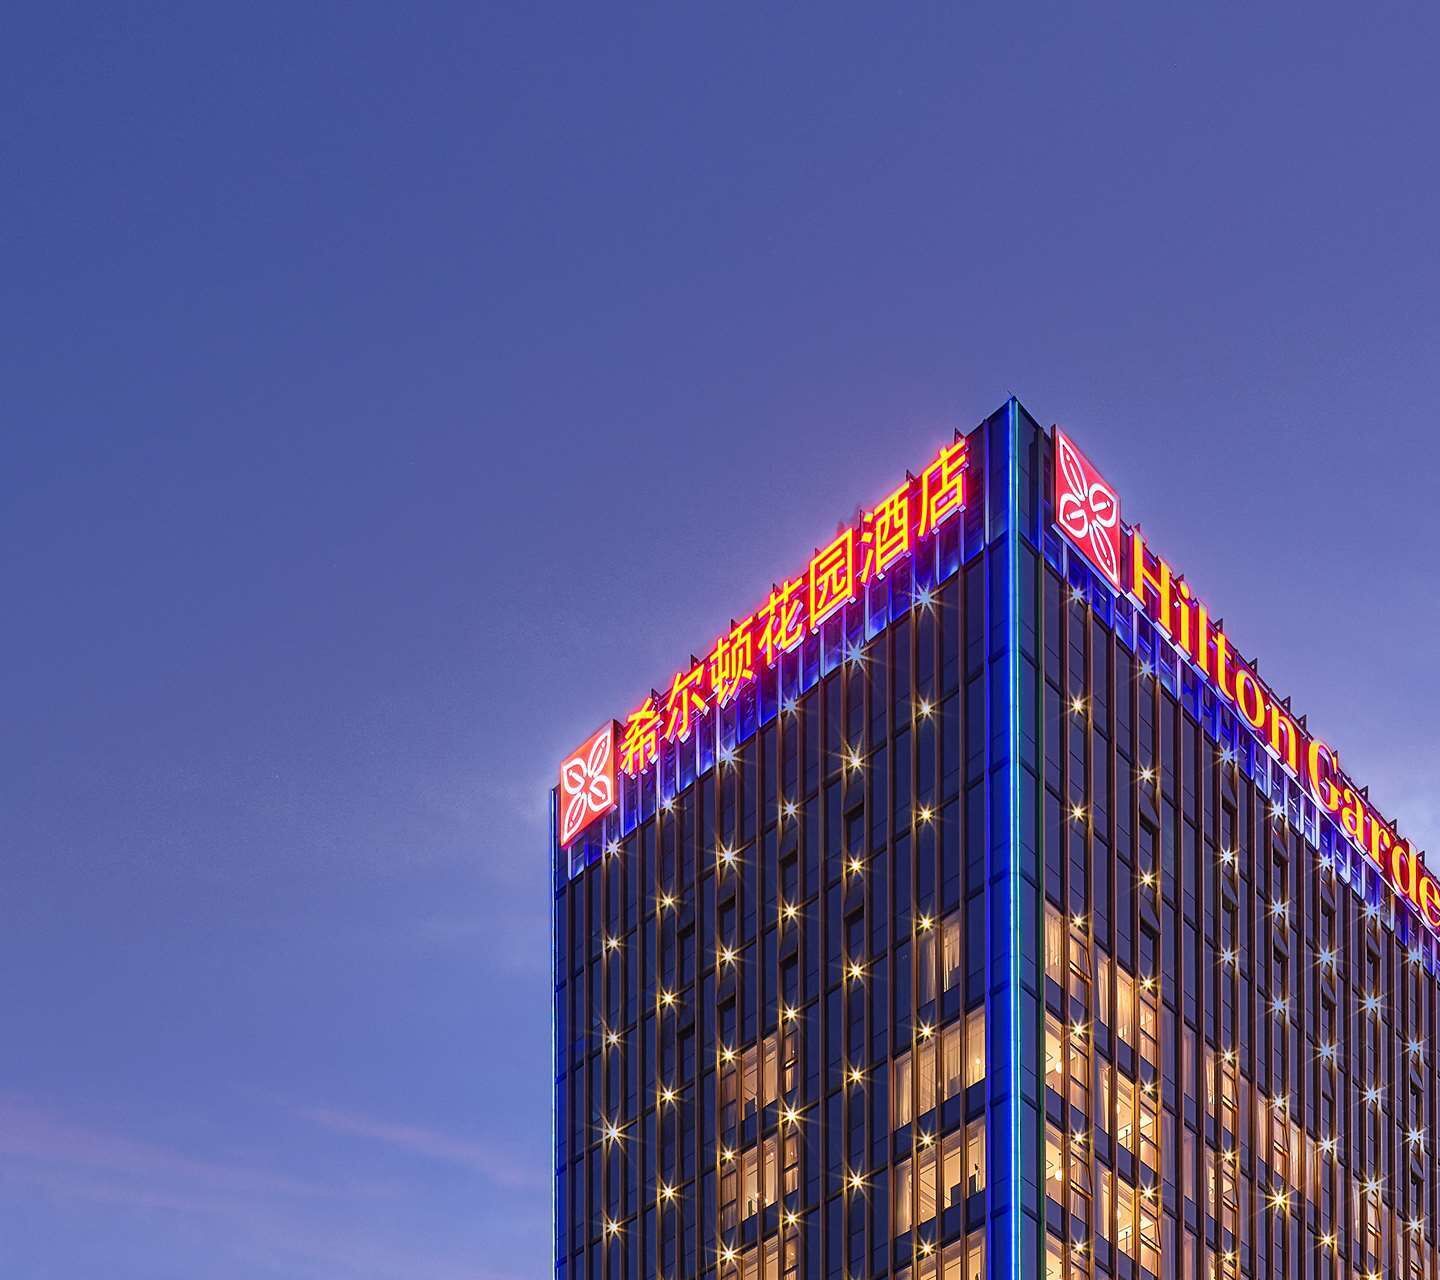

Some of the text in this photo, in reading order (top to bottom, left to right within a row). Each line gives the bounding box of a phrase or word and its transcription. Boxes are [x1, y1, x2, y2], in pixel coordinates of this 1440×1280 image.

[619, 439, 967, 775] 希尔顿花园酒店
[1132, 529, 1298, 774] Hilton
